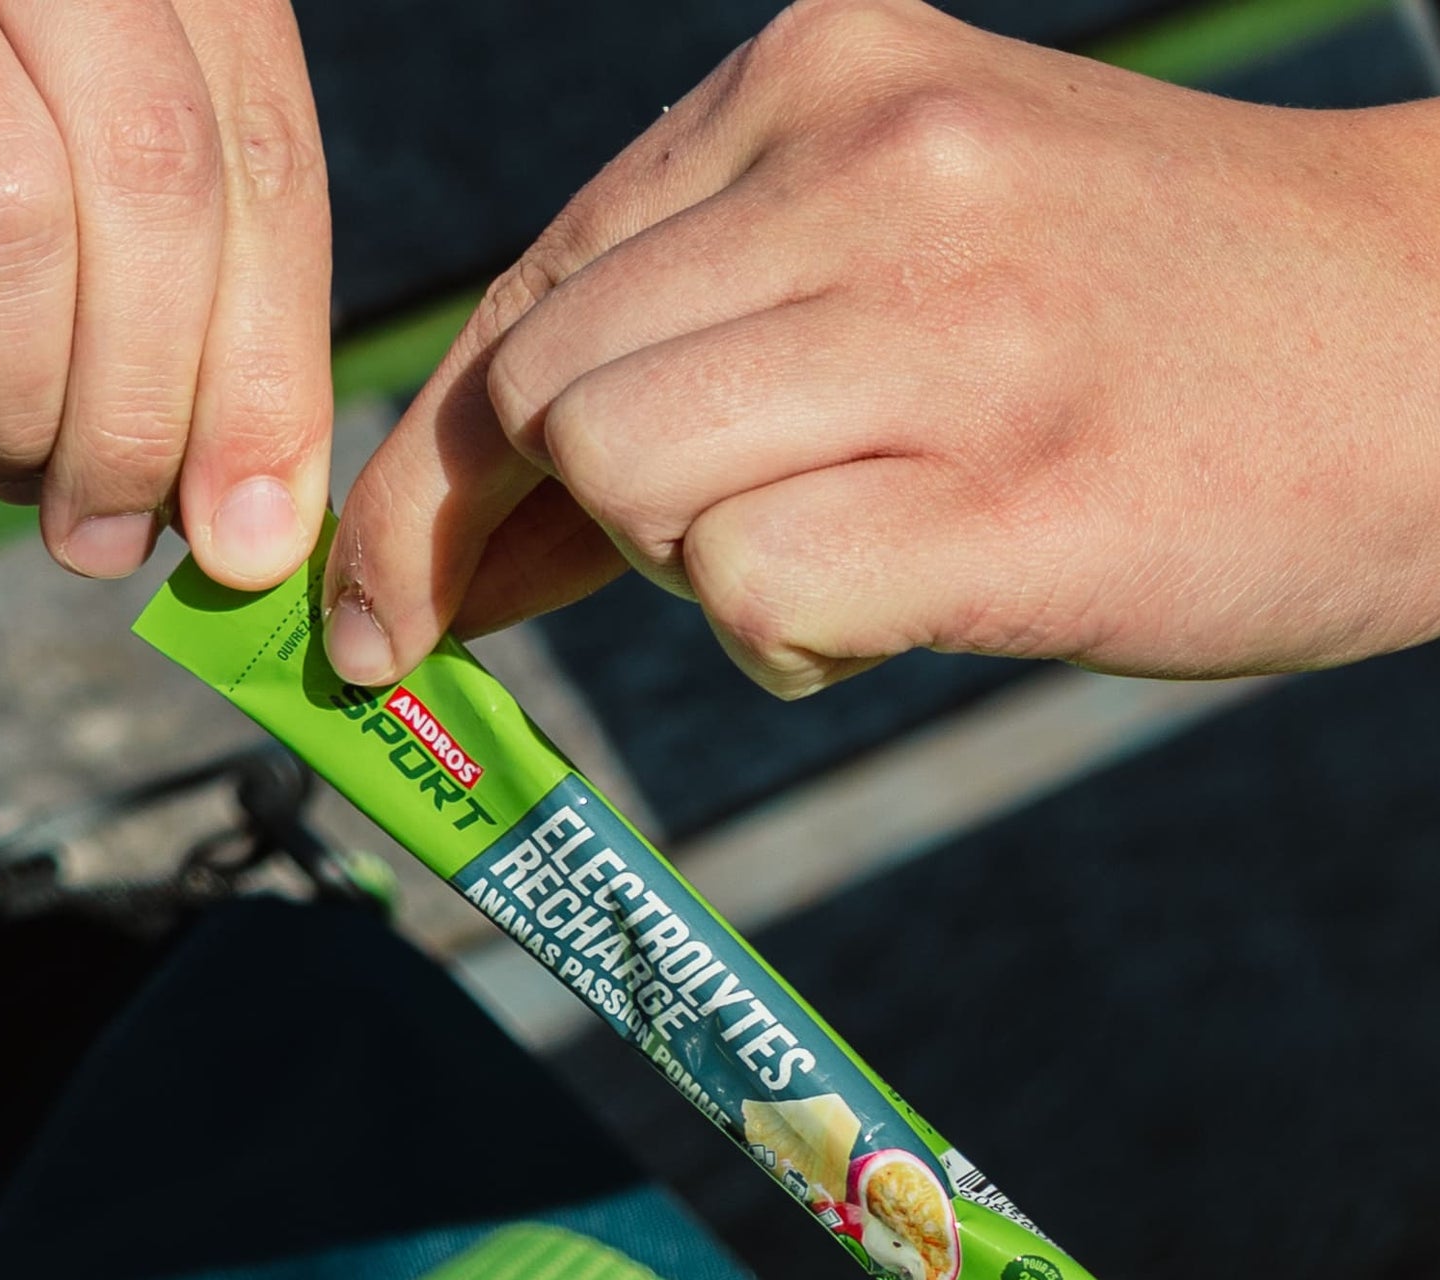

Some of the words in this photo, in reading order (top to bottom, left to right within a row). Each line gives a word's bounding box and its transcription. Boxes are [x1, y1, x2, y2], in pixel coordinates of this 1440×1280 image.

[277, 619, 313, 661] OUVREZ
[328, 683, 498, 831] SPORT
[389, 694, 478, 785] ANDROS
[464, 877, 562, 968] ANANAS
[560, 956, 655, 1052] PASSION
[651, 1044, 733, 1129] POMME
[489, 839, 700, 1042] RECHARGE
[532, 805, 817, 1091] ELECTROLYTES
[1022, 1257, 1046, 1274] POUR
